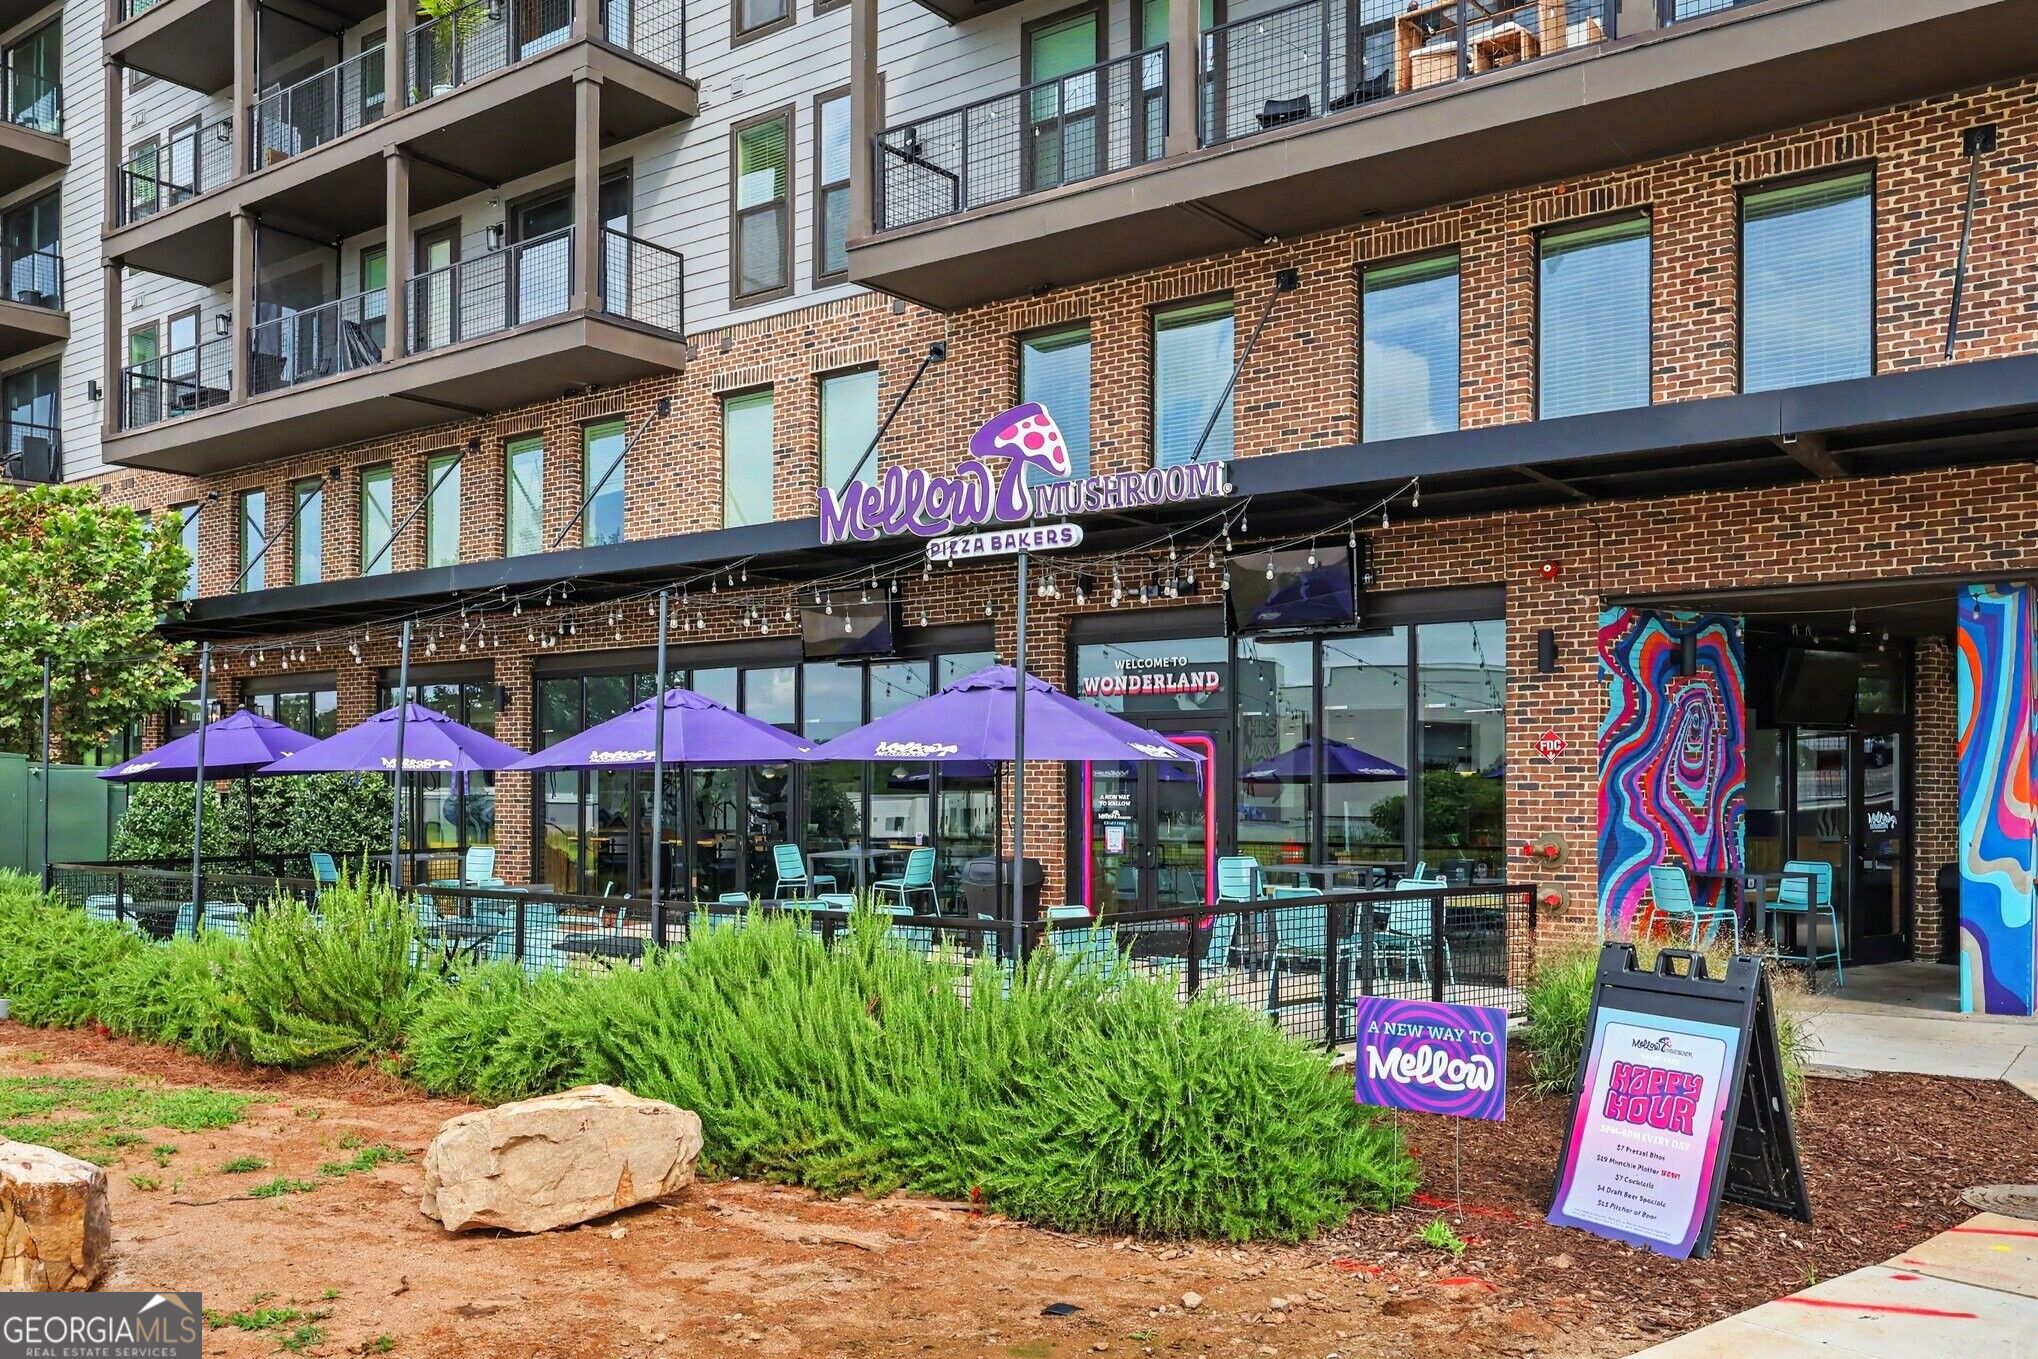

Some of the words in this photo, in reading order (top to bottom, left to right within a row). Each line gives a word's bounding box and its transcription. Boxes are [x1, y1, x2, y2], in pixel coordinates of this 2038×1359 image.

[817, 460, 993, 544] Mellow
[1034, 461, 1226, 518] MUSHROOM
[929, 536, 985, 558] PIZZA
[990, 527, 1073, 551] BAKERS
[1114, 657, 1170, 670] WELCOME
[1171, 656, 1188, 668] TO
[1083, 671, 1220, 697] WONDERLAND
[1540, 740, 1561, 751] FDC
[1368, 1021, 1379, 1033] A
[1384, 1023, 1423, 1038] NEW
[1427, 1025, 1465, 1042] WAY
[1469, 1030, 1494, 1045] TO
[1366, 1045, 1495, 1092] Mellow
[1609, 1060, 1704, 1102] HAPPY
[1603, 1088, 1696, 1135] HOUR
[1625, 1146, 1648, 1157] Pretzel
[1642, 1134, 1671, 1147] EVERY
[1672, 1140, 1691, 1151] DAY
[1609, 1158, 1636, 1169] Munchie
[1606, 1187, 1623, 1196] Draft
[1624, 1192, 1638, 1200] Beer
